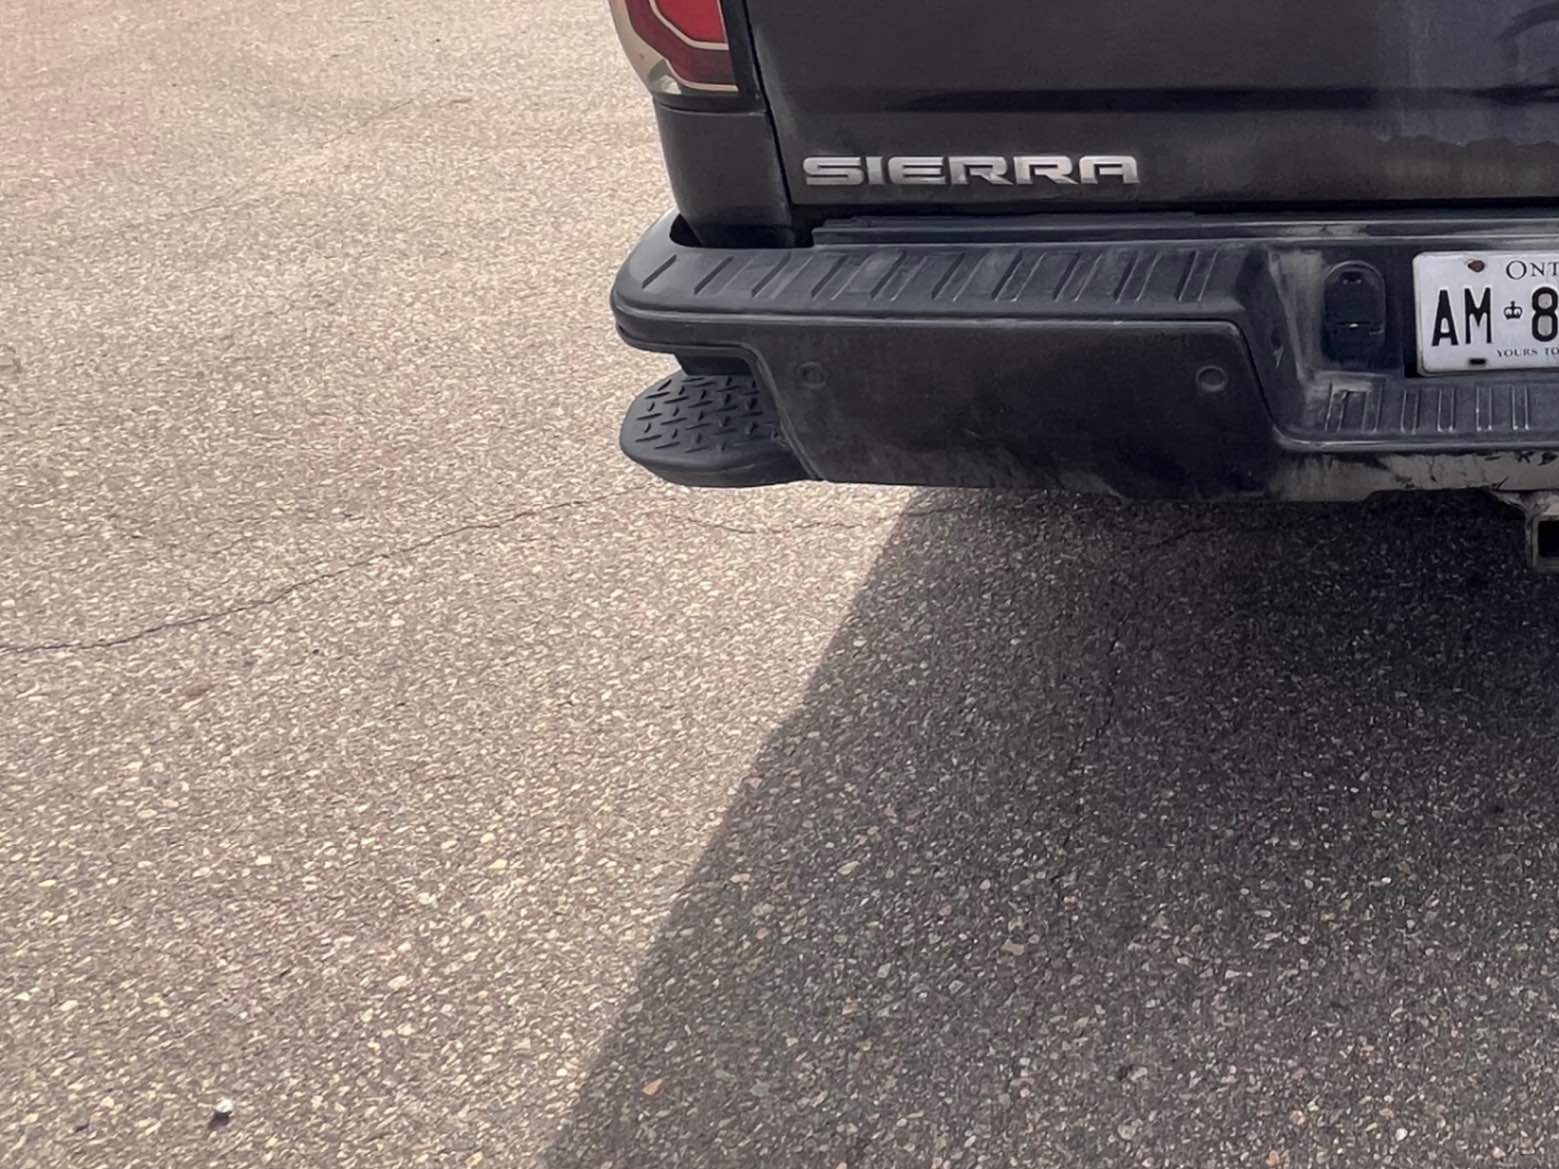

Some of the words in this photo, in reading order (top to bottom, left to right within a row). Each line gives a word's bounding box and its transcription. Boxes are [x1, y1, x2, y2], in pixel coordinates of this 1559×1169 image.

[803, 156, 1141, 185] SIERRA
[1431, 287, 1493, 346] AM
[1496, 348, 1538, 358] YOURS
